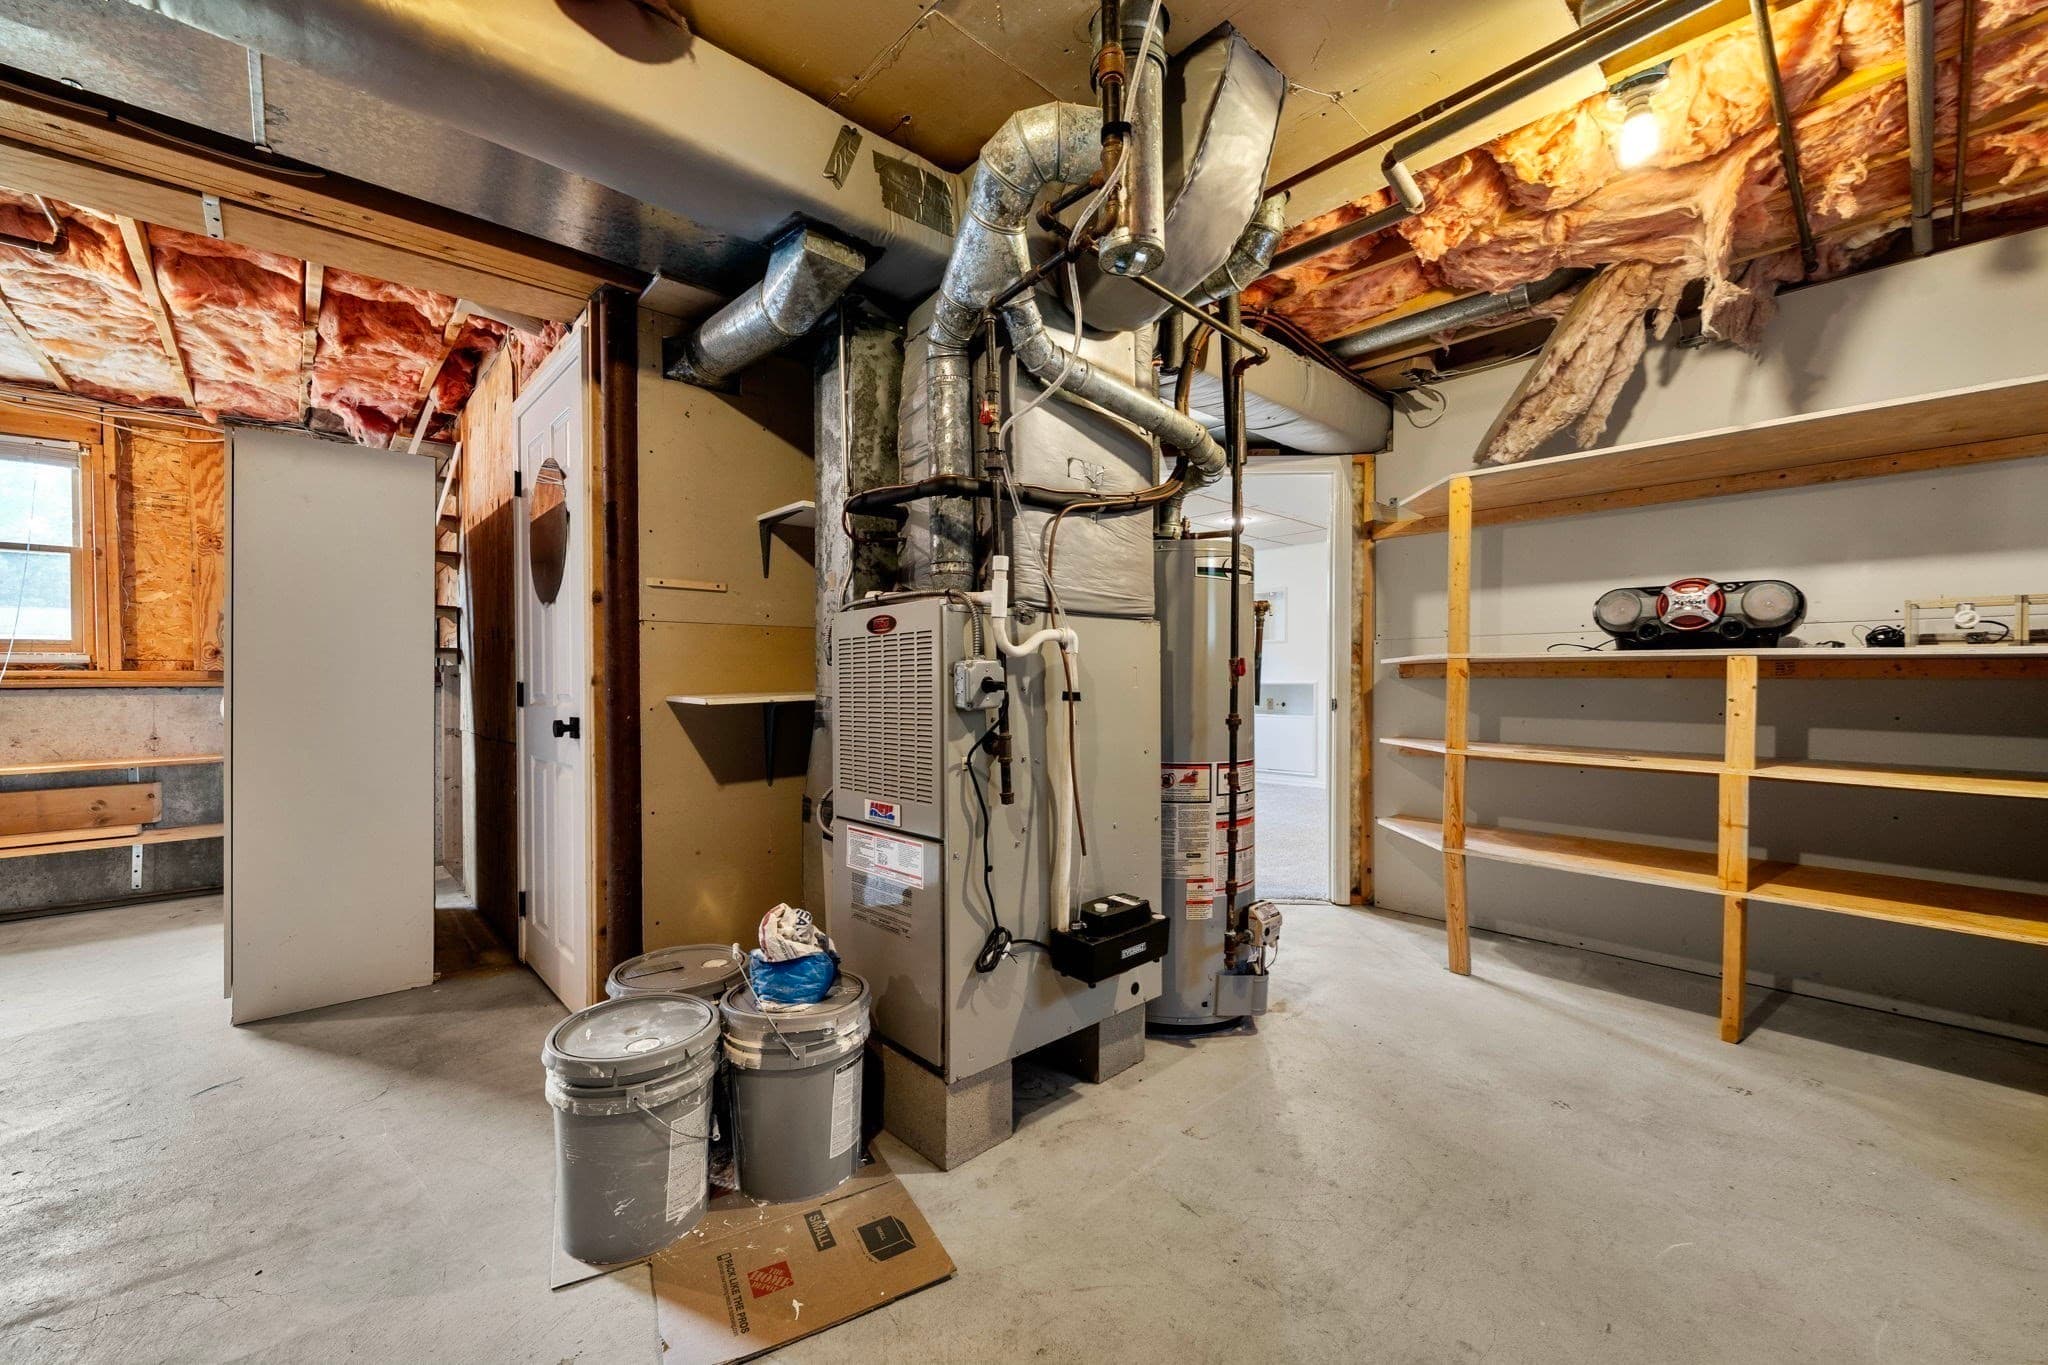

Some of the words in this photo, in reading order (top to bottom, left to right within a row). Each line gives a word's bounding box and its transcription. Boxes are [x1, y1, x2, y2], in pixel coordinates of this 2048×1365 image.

[808, 1214, 831, 1247] SMALL
[724, 1259, 737, 1277] PACK
[729, 1277, 741, 1295] LIKE
[733, 1294, 745, 1312] THE
[736, 1311, 750, 1334] PROS
